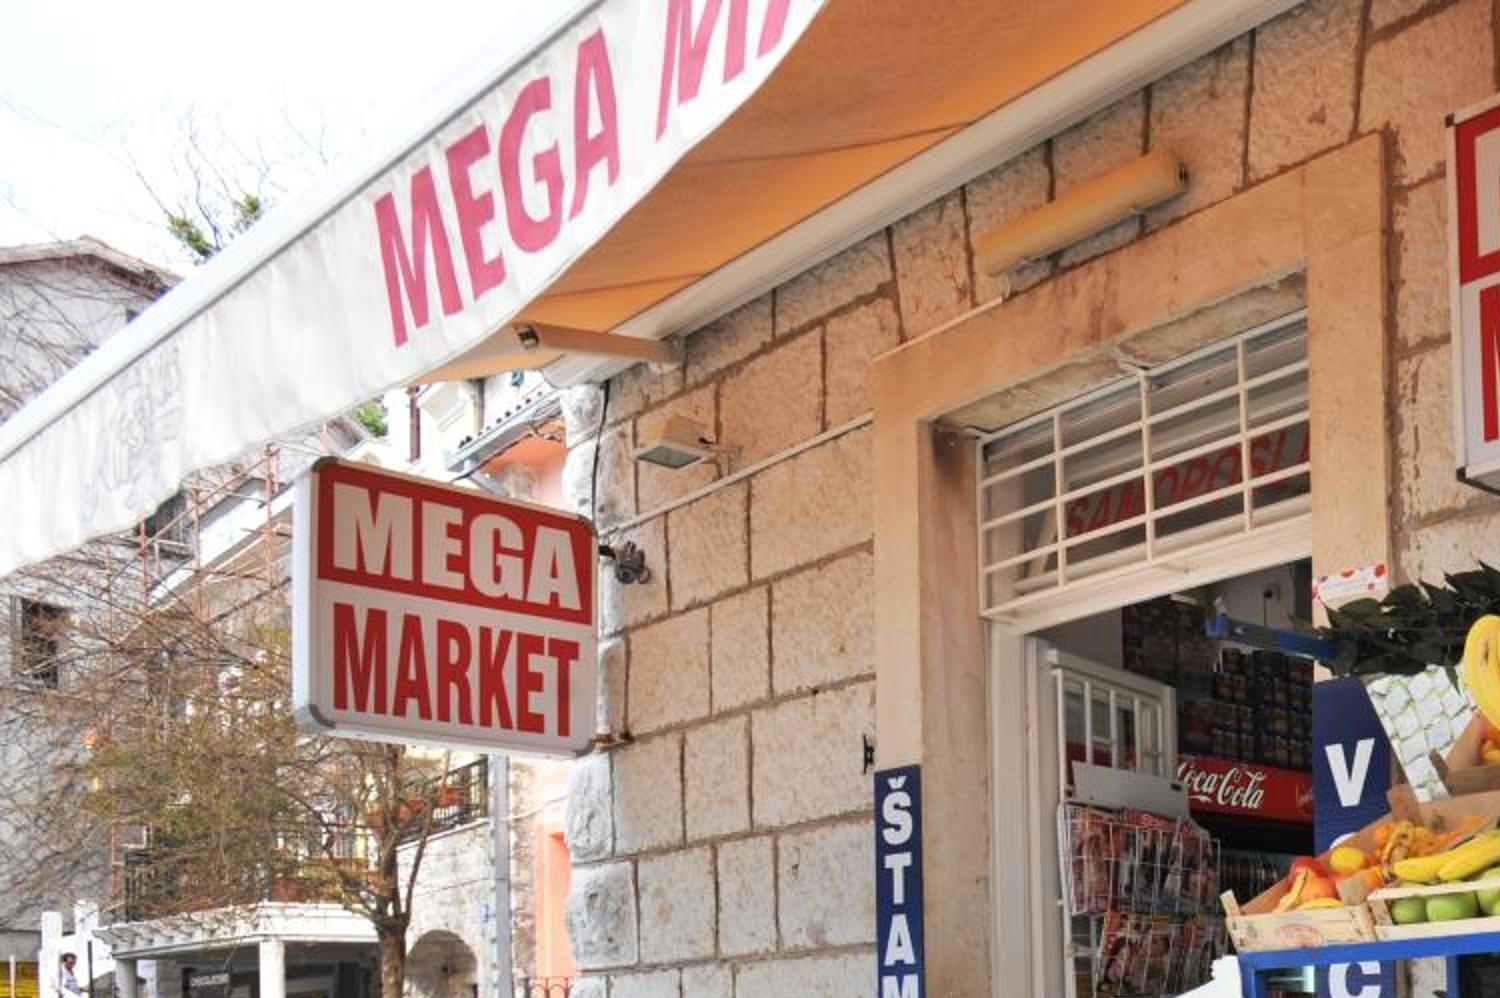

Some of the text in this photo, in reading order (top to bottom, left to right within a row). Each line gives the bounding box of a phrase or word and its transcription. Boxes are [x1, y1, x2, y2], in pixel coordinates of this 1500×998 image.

[373, 26, 620, 347] MEGA
[332, 482, 583, 610] MEGA
[332, 602, 580, 738] MARKET
